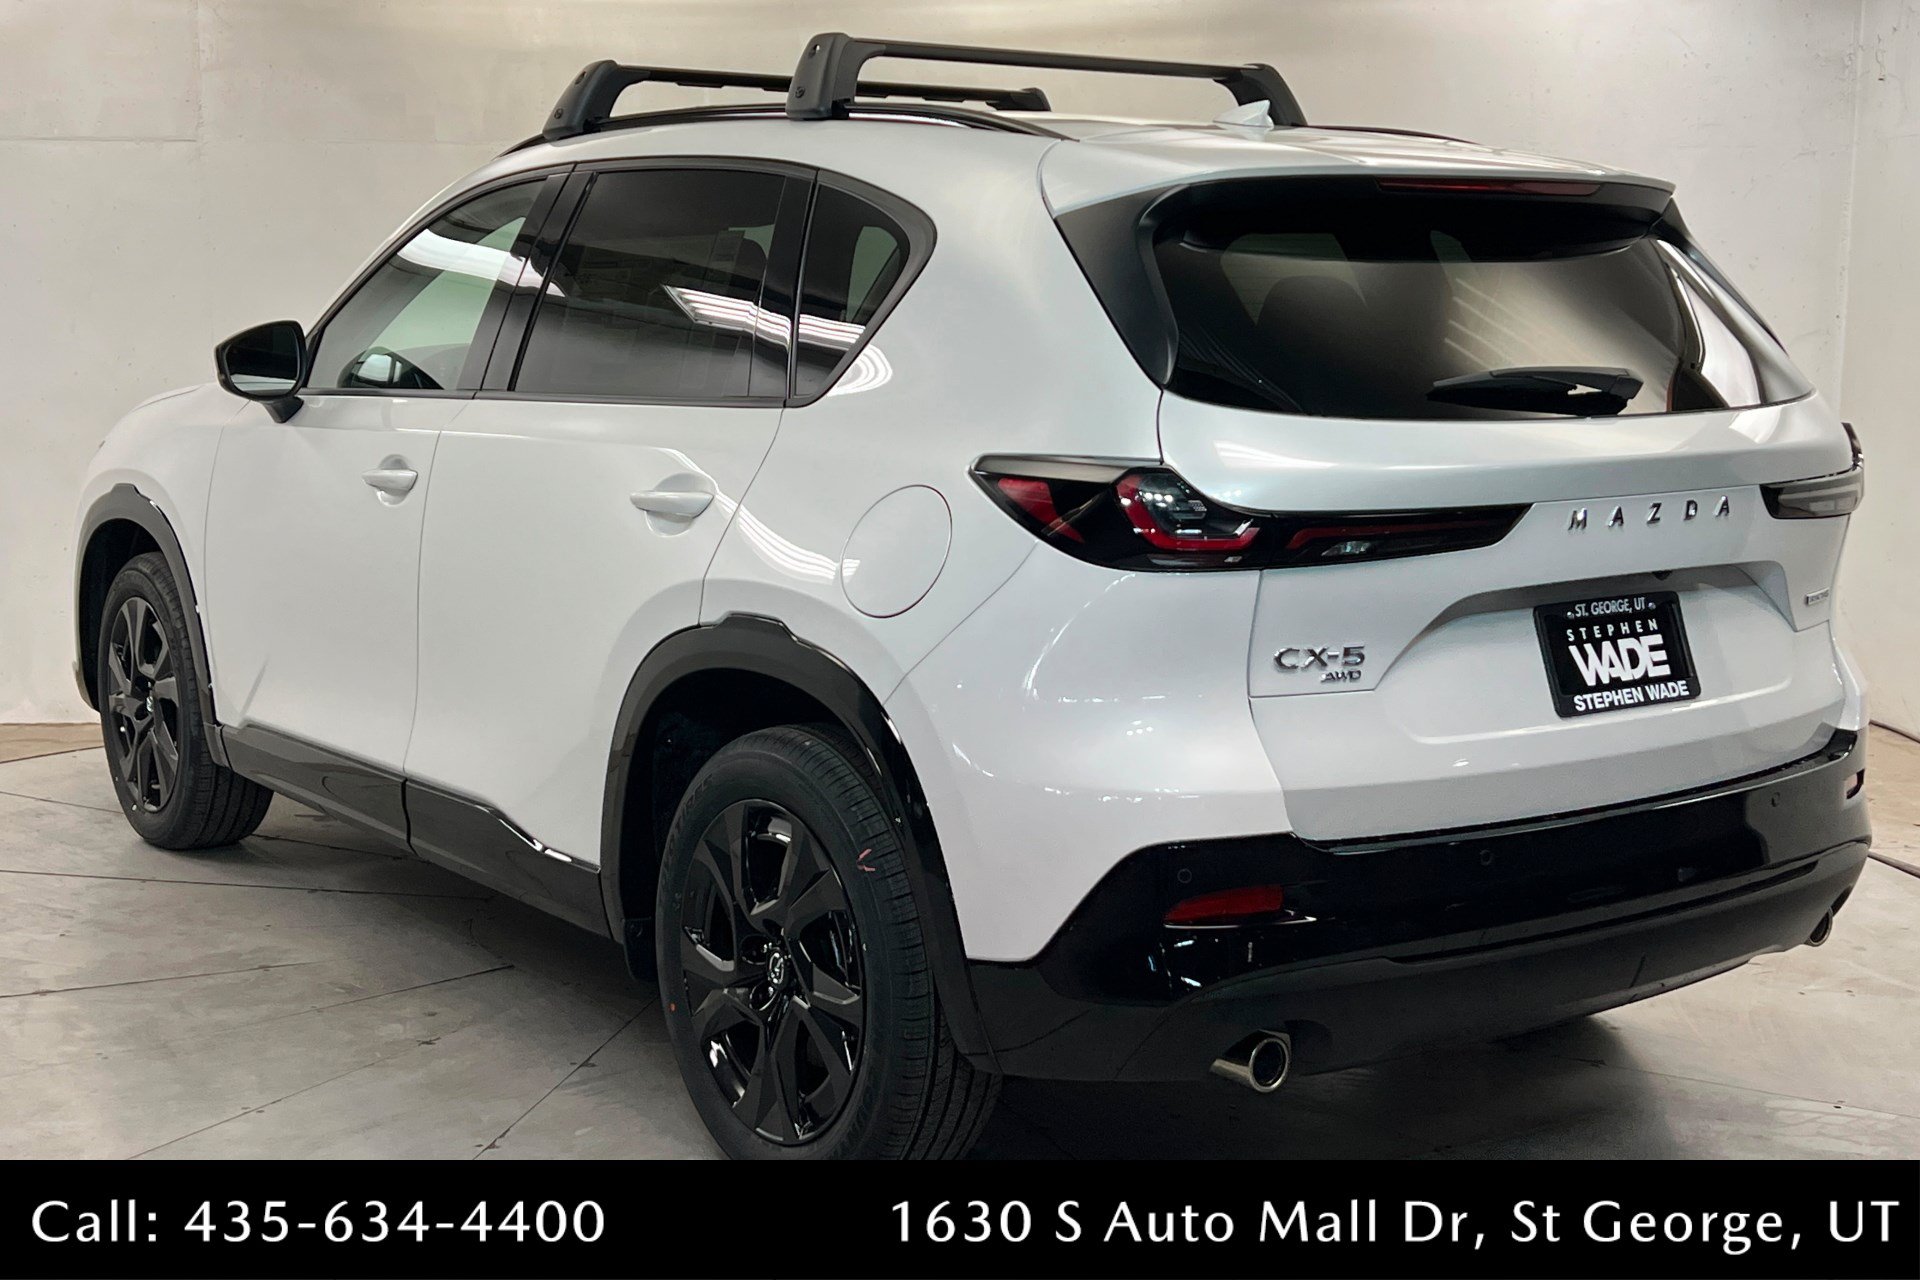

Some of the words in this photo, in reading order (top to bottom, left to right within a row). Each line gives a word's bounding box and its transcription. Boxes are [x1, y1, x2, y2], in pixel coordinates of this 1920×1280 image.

[1568, 495, 1730, 531] MAZDA
[1574, 603, 1589, 618] ST.
[1591, 598, 1633, 614] GEORGE,
[1634, 597, 1646, 610] UT
[1566, 619, 1658, 641] STEPHEN
[1274, 642, 1365, 669] CX-5
[1568, 634, 1671, 686] WADE
[1321, 670, 1362, 682] AWD
[1574, 687, 1644, 712] STEPHEN
[1646, 680, 1689, 701] WADE
